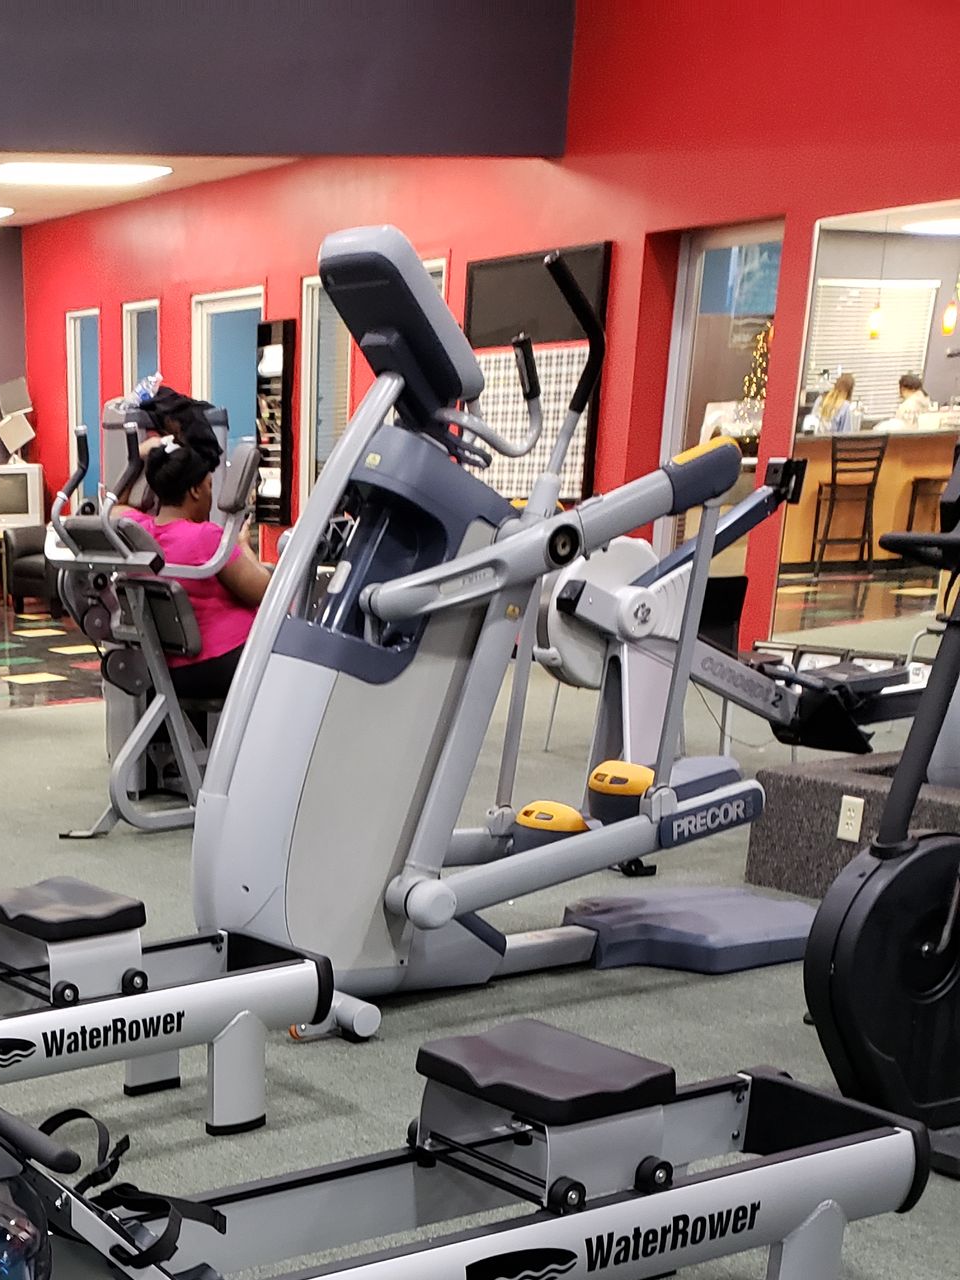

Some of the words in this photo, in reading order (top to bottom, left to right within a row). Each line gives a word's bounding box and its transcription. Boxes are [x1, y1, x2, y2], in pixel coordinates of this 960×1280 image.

[672, 799, 745, 841] PRECOR
[42, 1010, 185, 1058] WaterRower
[586, 1200, 761, 1272] WaterRower
